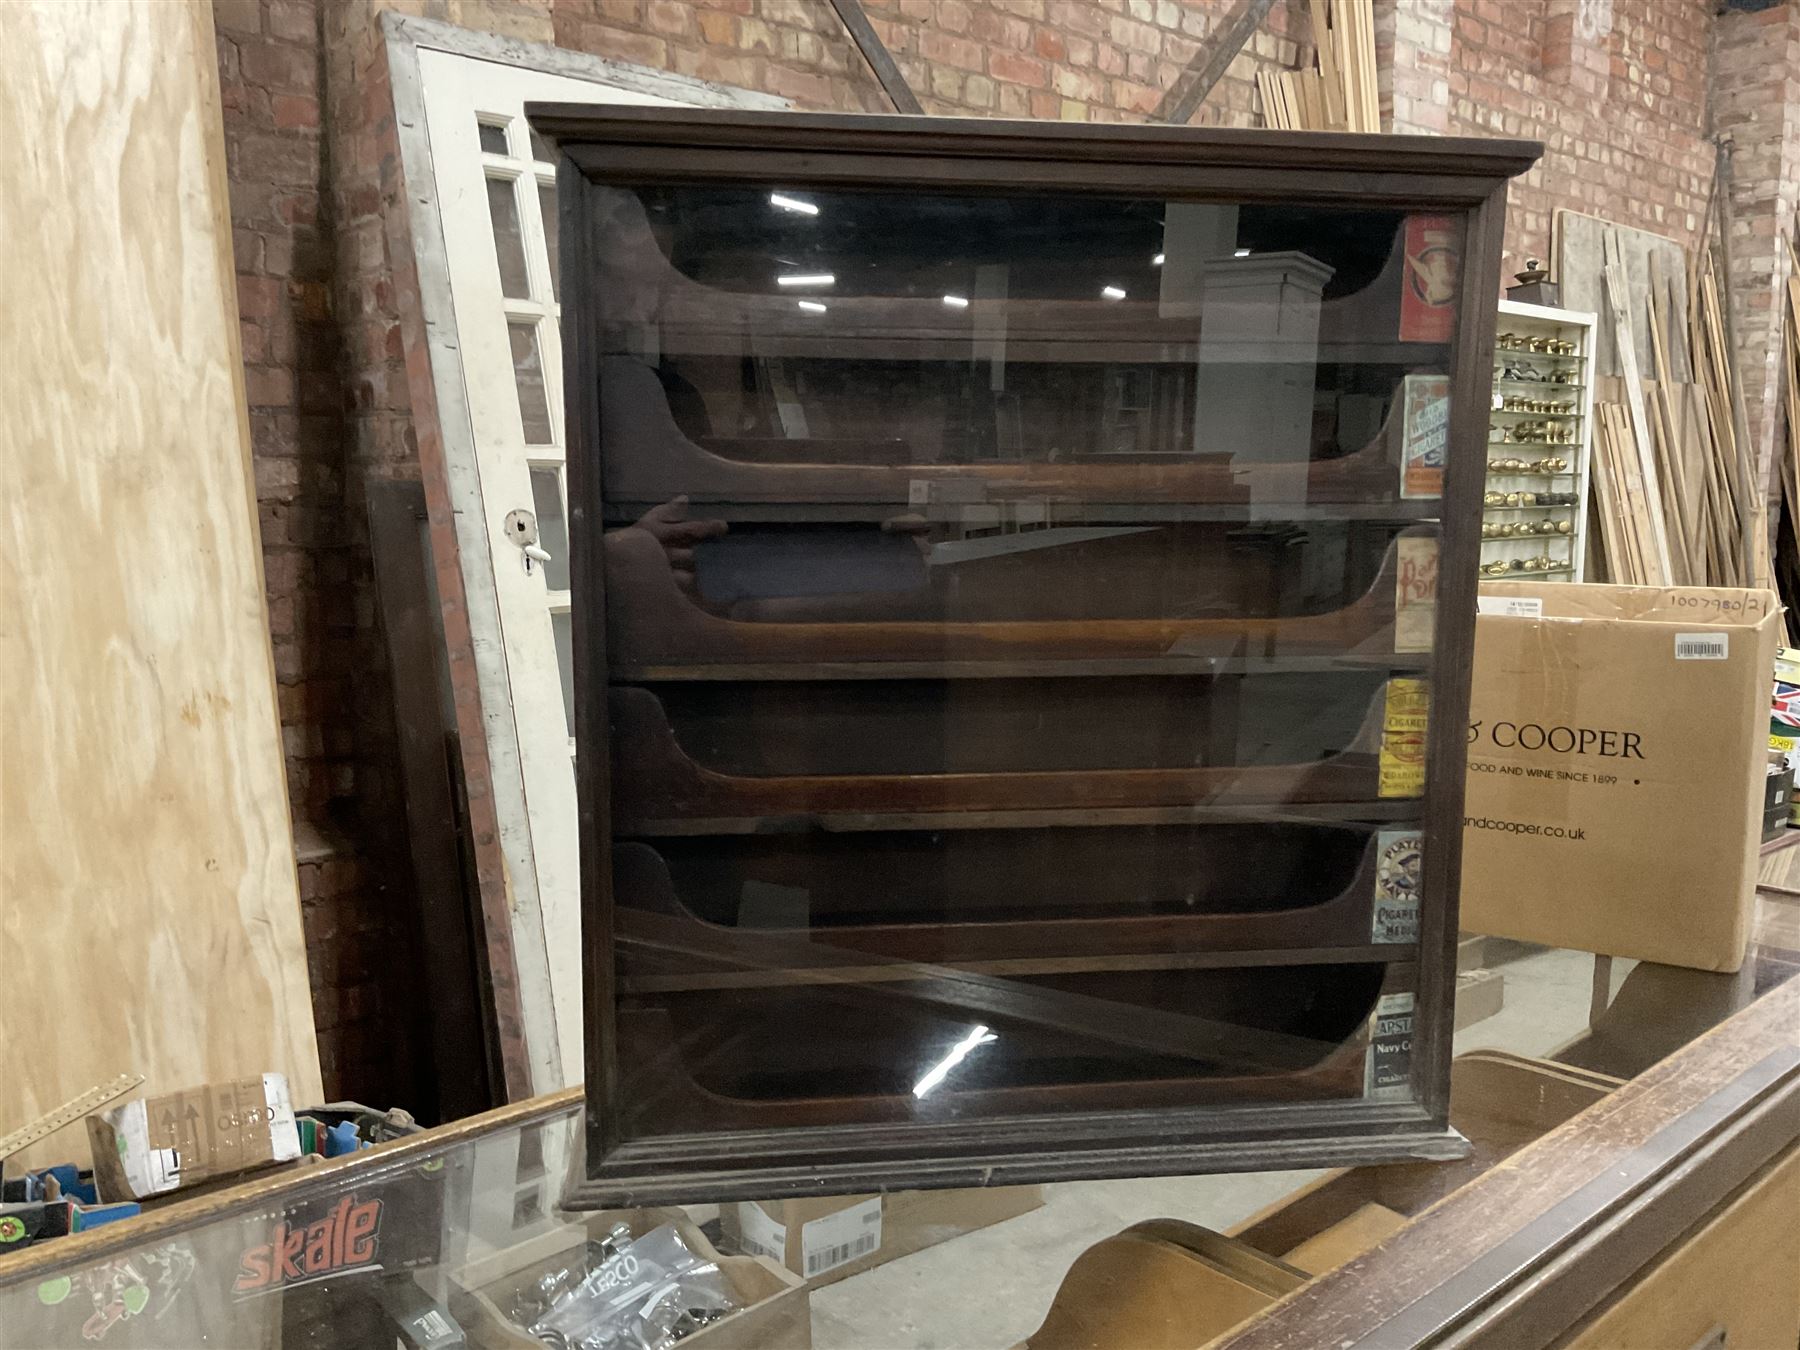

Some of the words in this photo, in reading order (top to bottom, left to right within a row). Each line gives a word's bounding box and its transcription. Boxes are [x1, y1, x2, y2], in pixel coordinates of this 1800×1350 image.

[1491, 720, 1647, 760] COOPER
[1466, 762, 1496, 774] OOD
[1499, 765, 1524, 776] AND
[1525, 768, 1555, 780] WINE
[1556, 770, 1589, 783] SINCE
[1592, 773, 1618, 785] 1899
[1376, 1043, 1400, 1054] Navy
